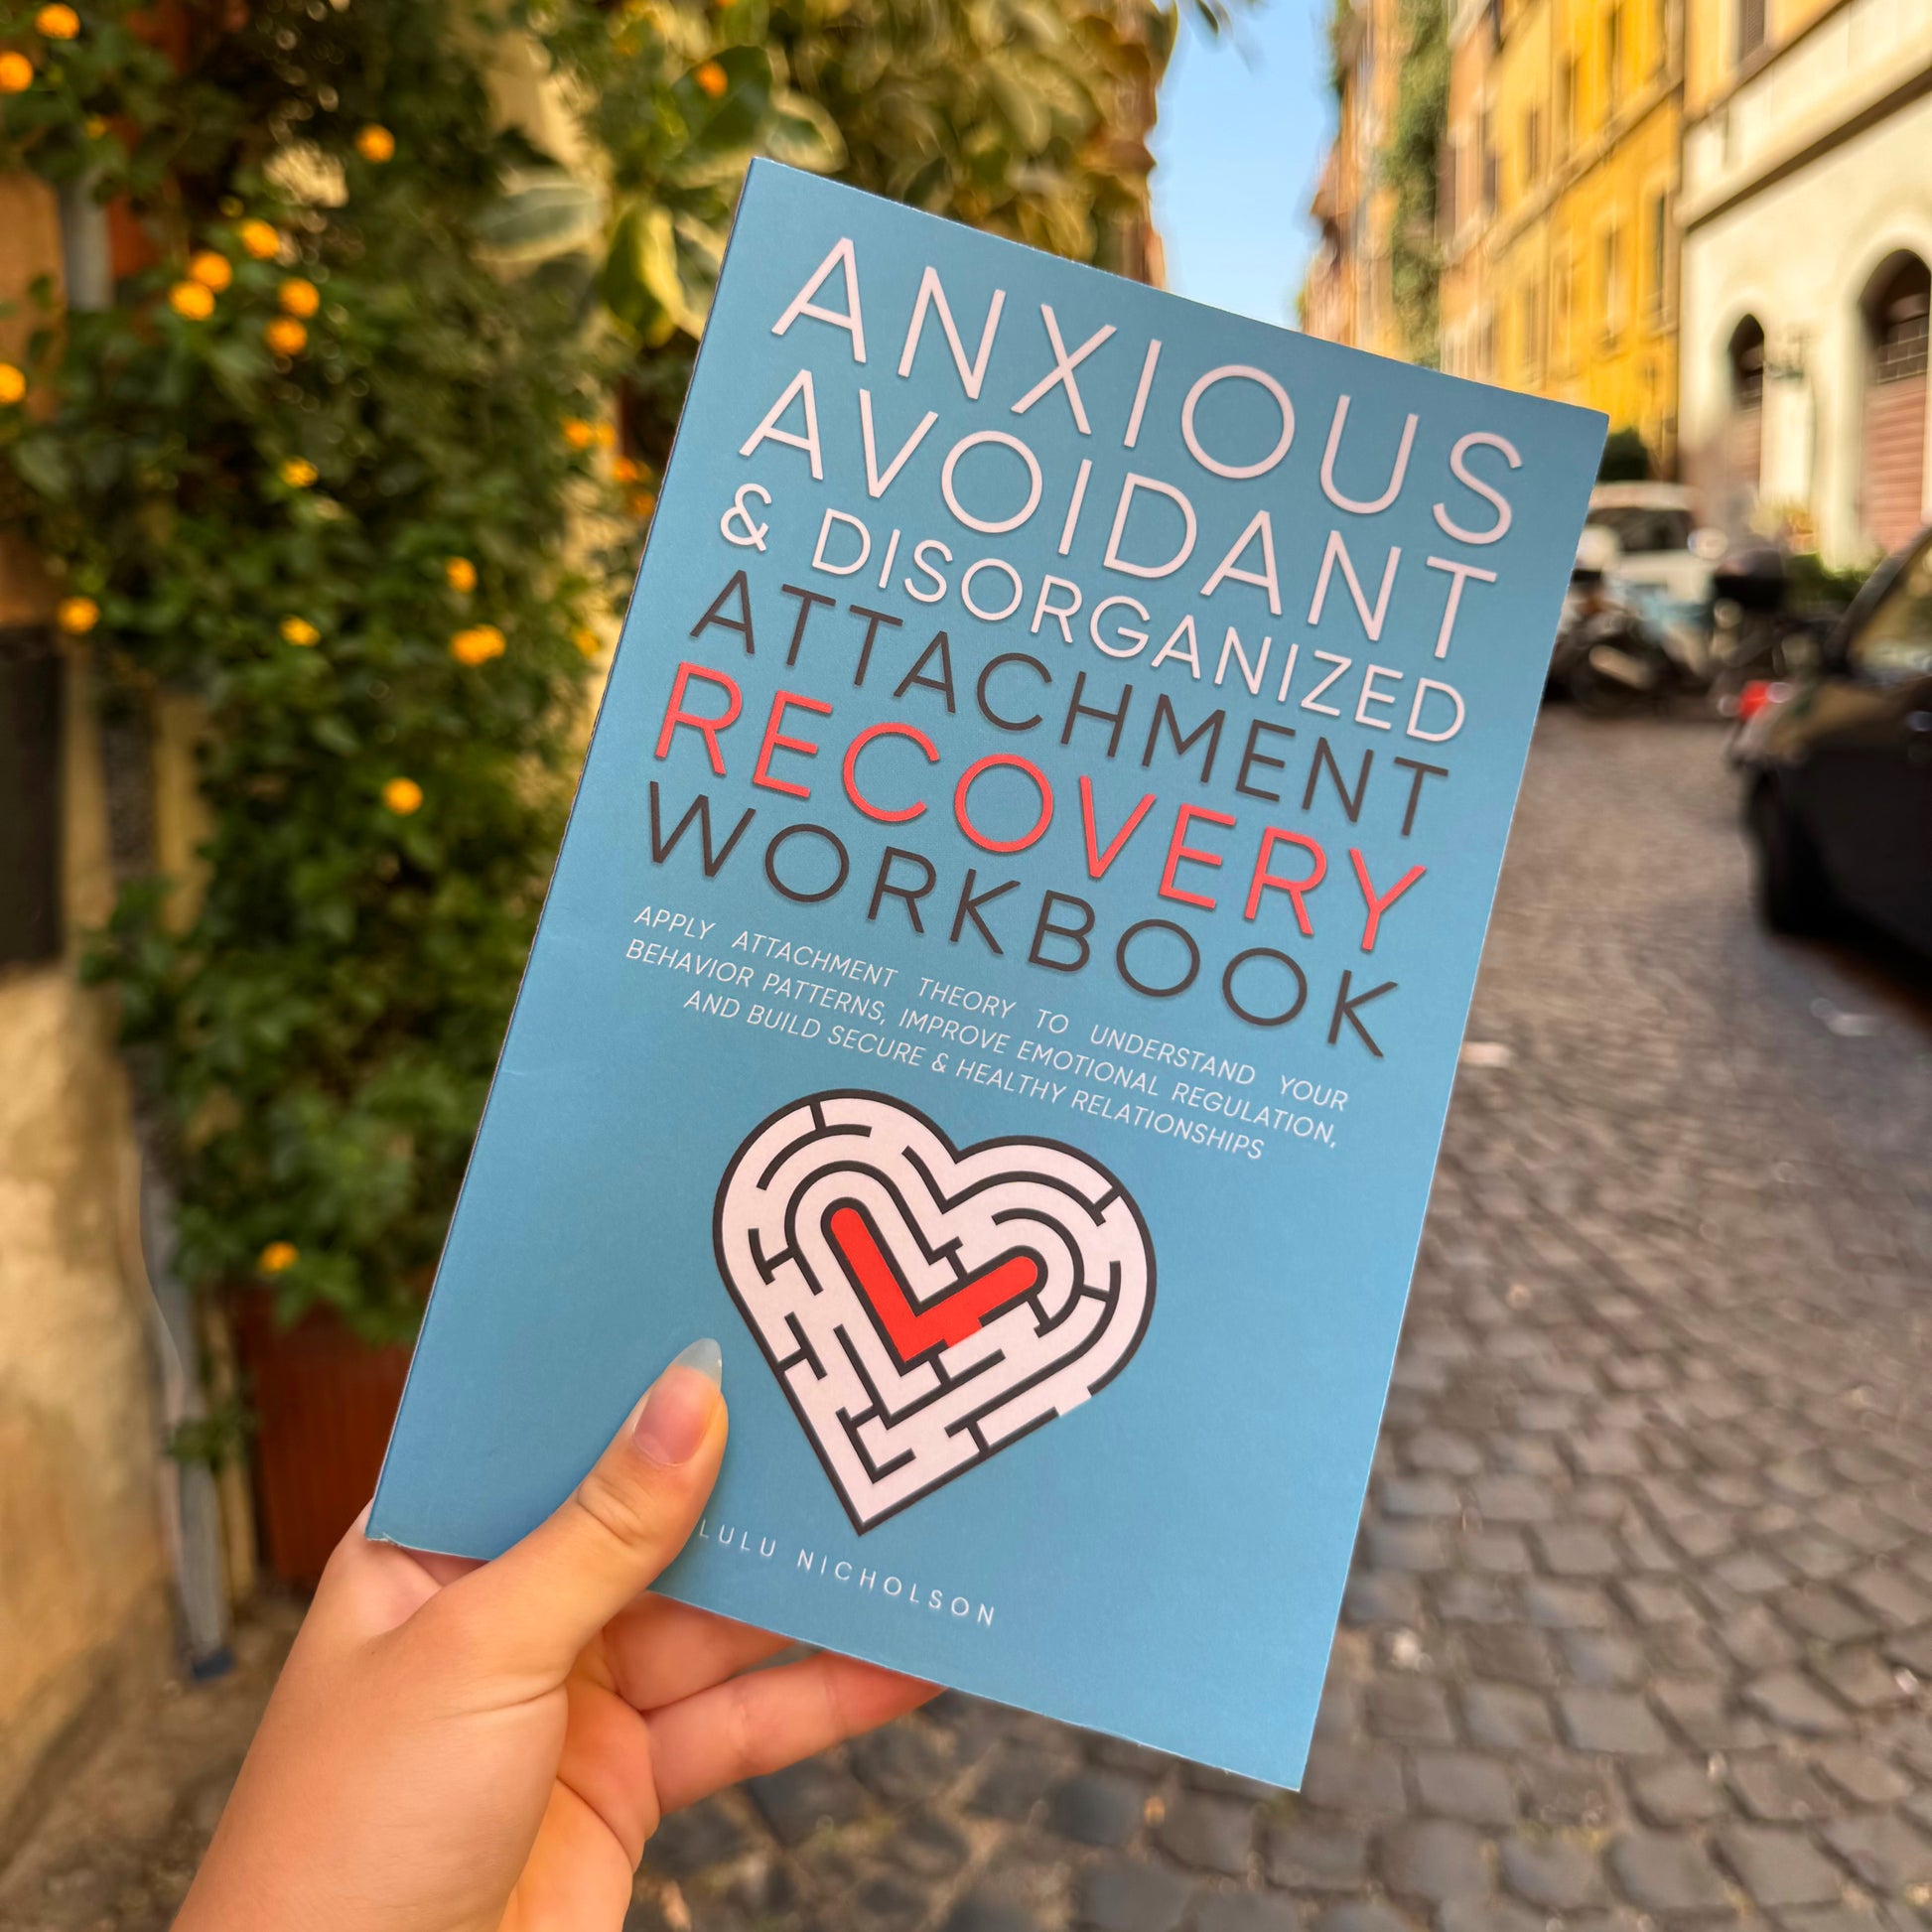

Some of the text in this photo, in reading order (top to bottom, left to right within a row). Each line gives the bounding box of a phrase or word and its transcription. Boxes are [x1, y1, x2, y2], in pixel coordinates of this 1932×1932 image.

[740, 368, 1497, 661] AVOIDANT
[771, 238, 1524, 545] ANXIOUS
[692, 571, 1448, 838] ATTACHMENT
[719, 482, 1466, 743] & DISORGANIZED
[648, 781, 1401, 1059] WORKBOOK
[655, 663, 1427, 954] RECOVERY
[626, 939, 1337, 1148] BEHAVIOR PATTERNS, IMPROVE EMOTIONAL REGULATION,
[634, 904, 1348, 1112] APPLY ATTACHMENT THEORY TO UNDERSTAND YOUR
[684, 991, 1265, 1161] AND BUILD SECURE & HEALTHY RELATIONSHIPS
[699, 1519, 994, 1626] LULU NICHOLSON
